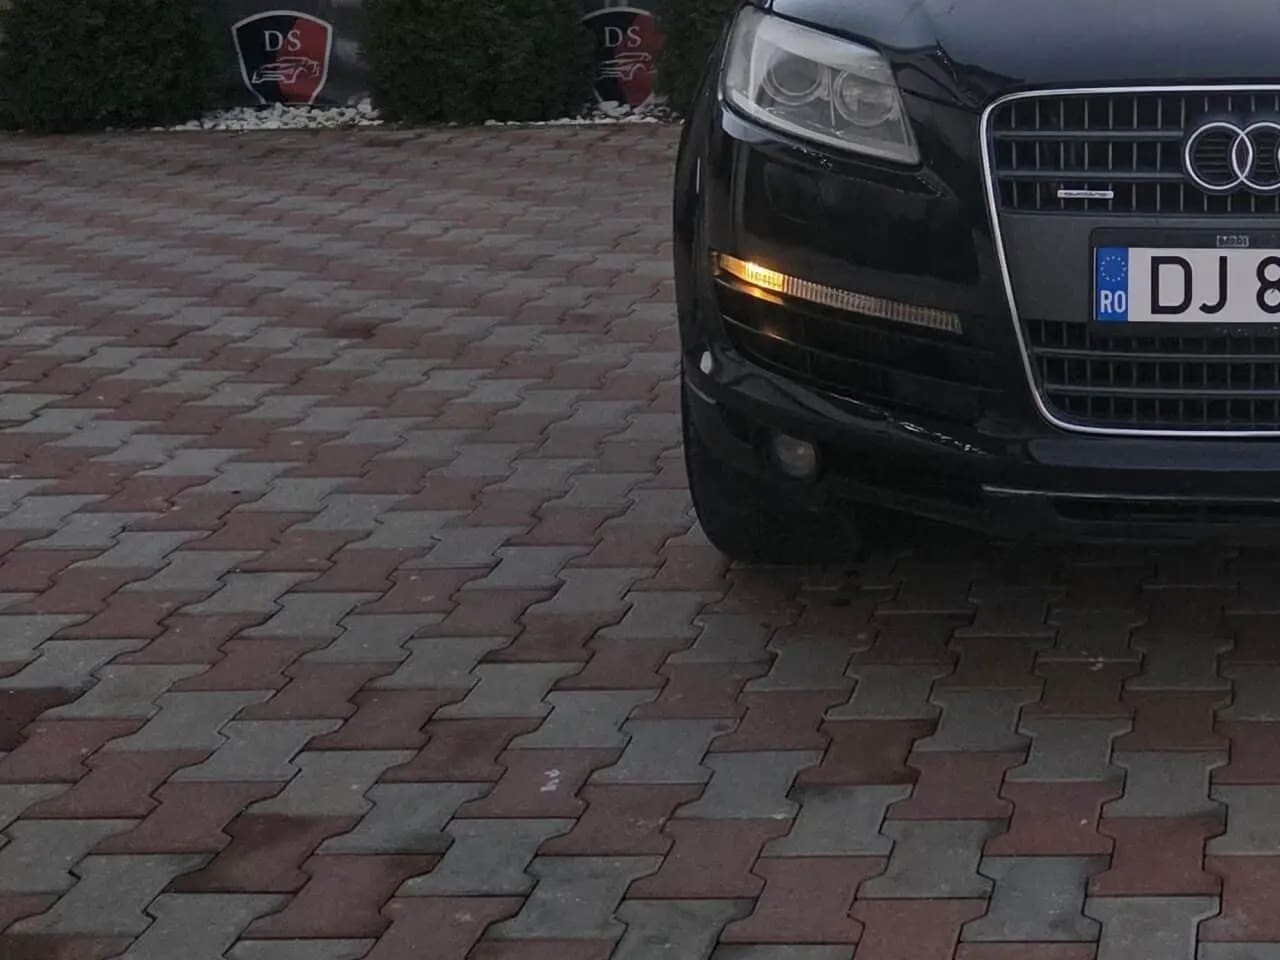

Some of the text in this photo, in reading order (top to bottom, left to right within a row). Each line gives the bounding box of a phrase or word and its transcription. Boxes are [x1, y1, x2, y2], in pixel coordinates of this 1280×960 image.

[263, 28, 301, 52] DS
[604, 25, 642, 48] DS
[1150, 256, 1228, 315] DJ
[1100, 290, 1127, 313] RO
